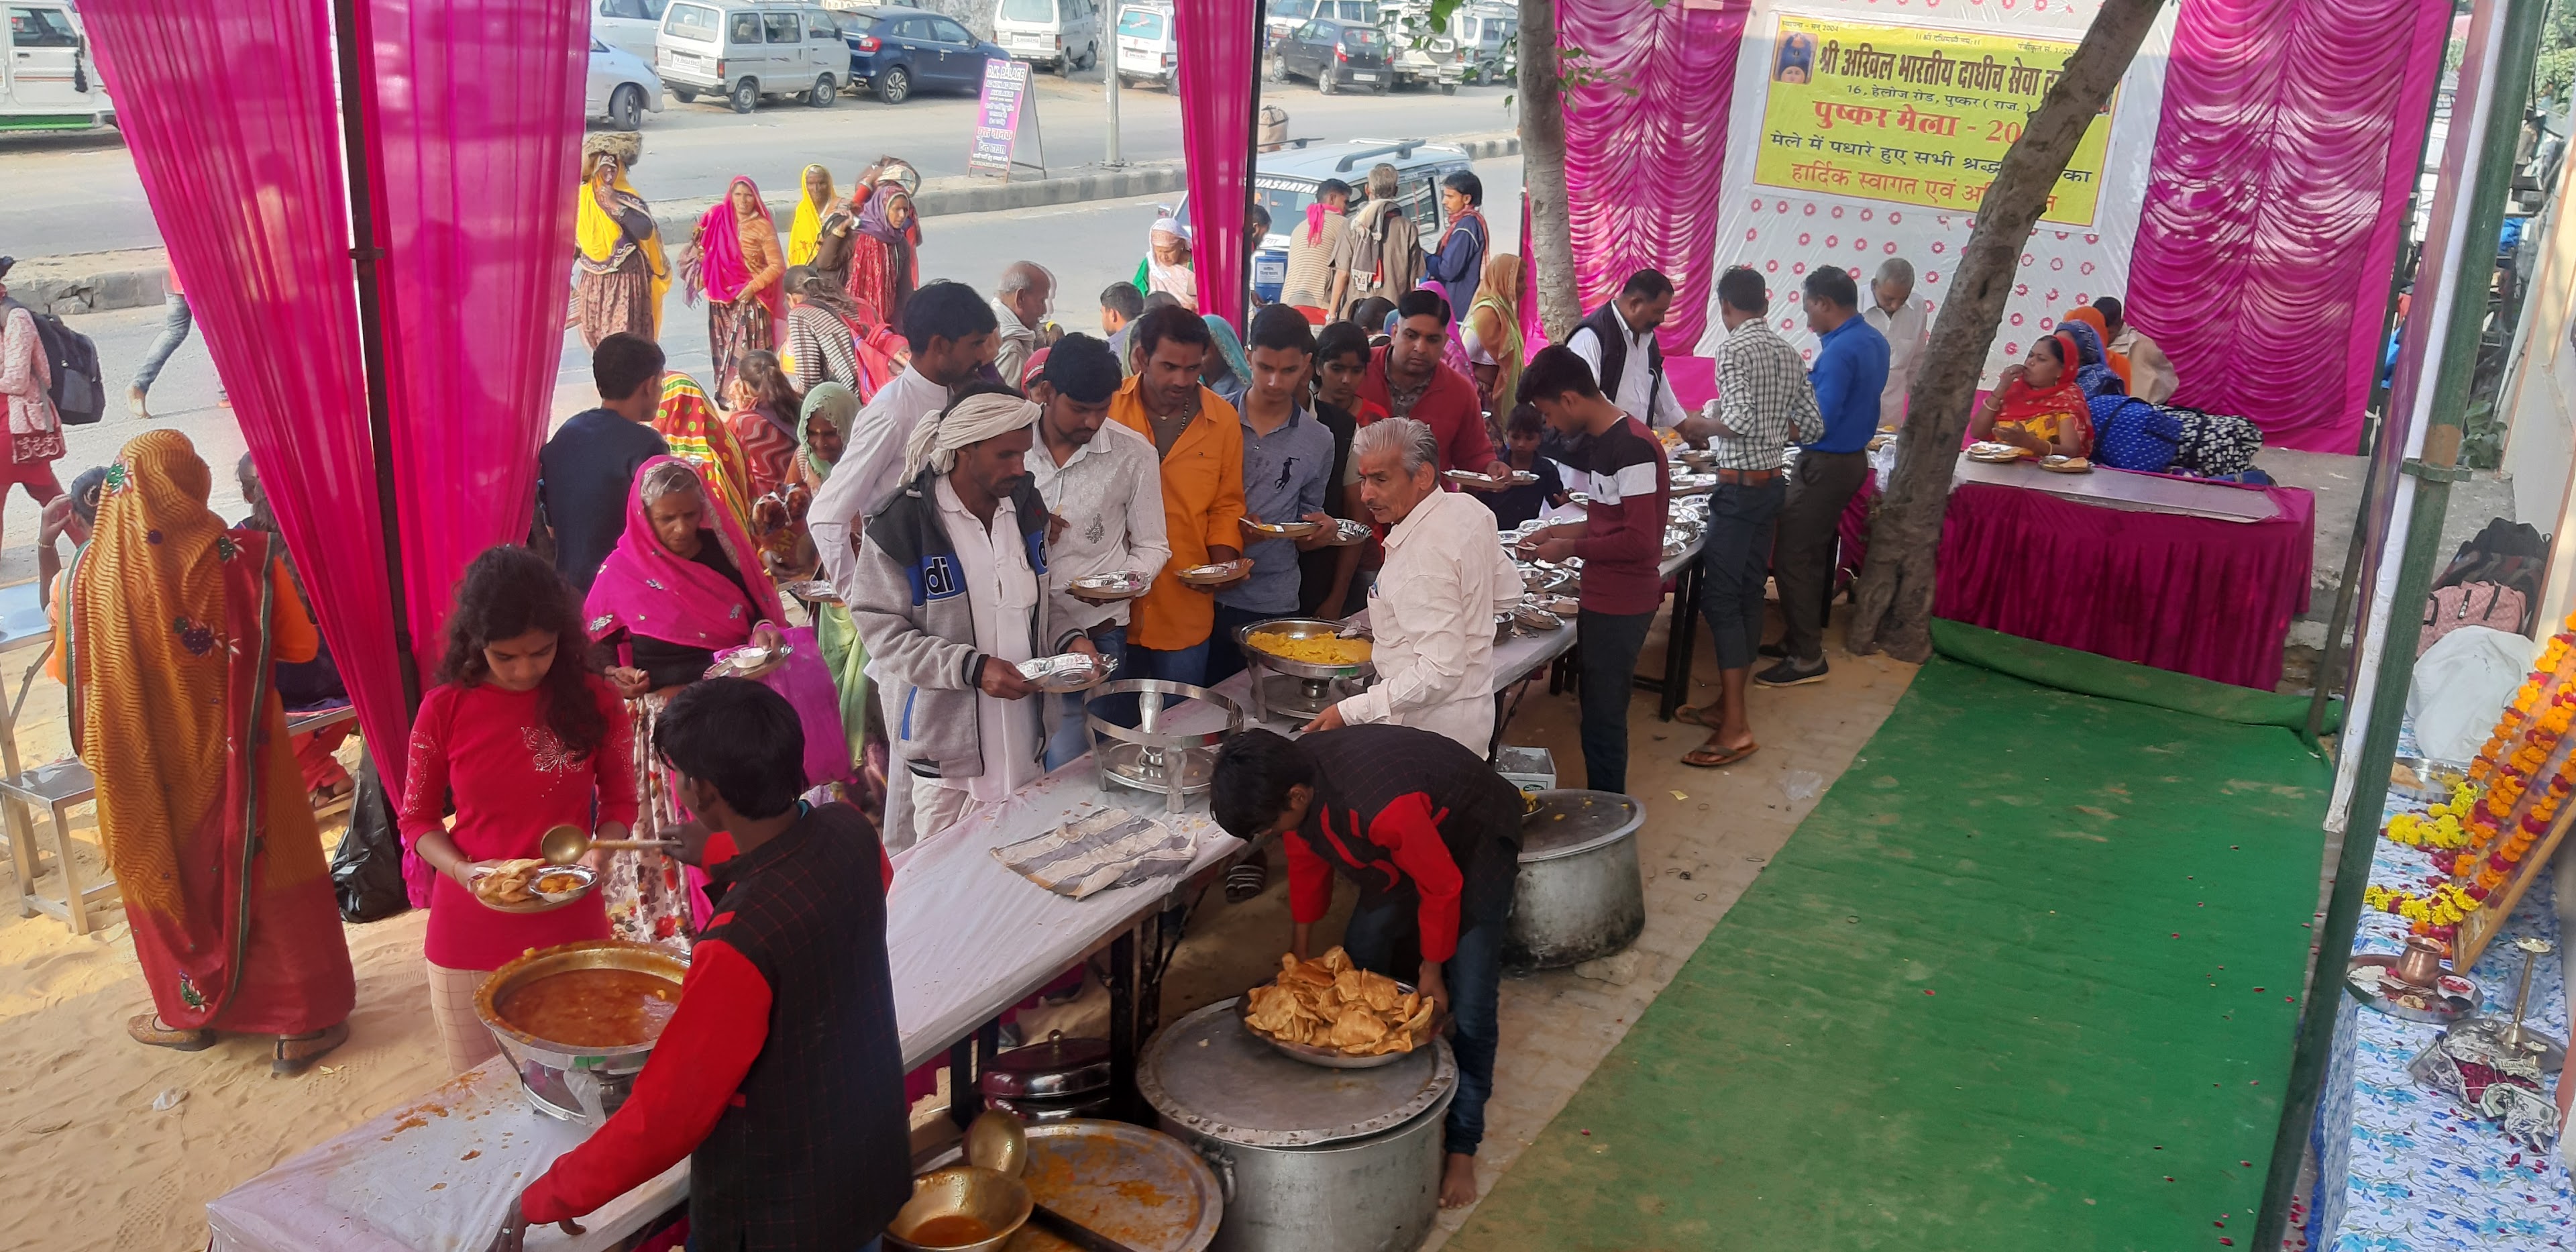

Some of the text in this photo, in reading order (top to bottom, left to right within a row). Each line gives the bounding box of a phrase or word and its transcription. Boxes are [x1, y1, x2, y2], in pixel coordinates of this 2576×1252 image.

[1000, 66, 1025, 81] PALACE
[1819, 38, 1841, 75] श्री
[1841, 42, 1896, 81] अखिल
[1898, 48, 1956, 87] भारतीय
[1957, 54, 2007, 93] दाधीच
[2007, 56, 2043, 96] सेवा
[1846, 85, 1868, 97] 16,
[1871, 85, 1908, 100] हेलोज
[1913, 91, 1940, 104] रोड,
[1944, 95, 1980, 107] पुष्कर
[1994, 101, 2021, 111] राज.
[1812, 99, 1892, 129] पुष्कर
[1896, 103, 1961, 137] मेला
[1985, 119, 2022, 144] 20
[1770, 129, 1803, 148] मेले
[1807, 134, 1825, 151] में
[1829, 140, 1875, 158] पधारे
[1880, 147, 1908, 166] हुए
[1914, 150, 1955, 168] सभी
[2063, 168, 2092, 183] का
[1791, 159, 1852, 187] हार्दिक
[1858, 171, 1919, 195] स्वागत
[1924, 177, 1957, 204] एवं
